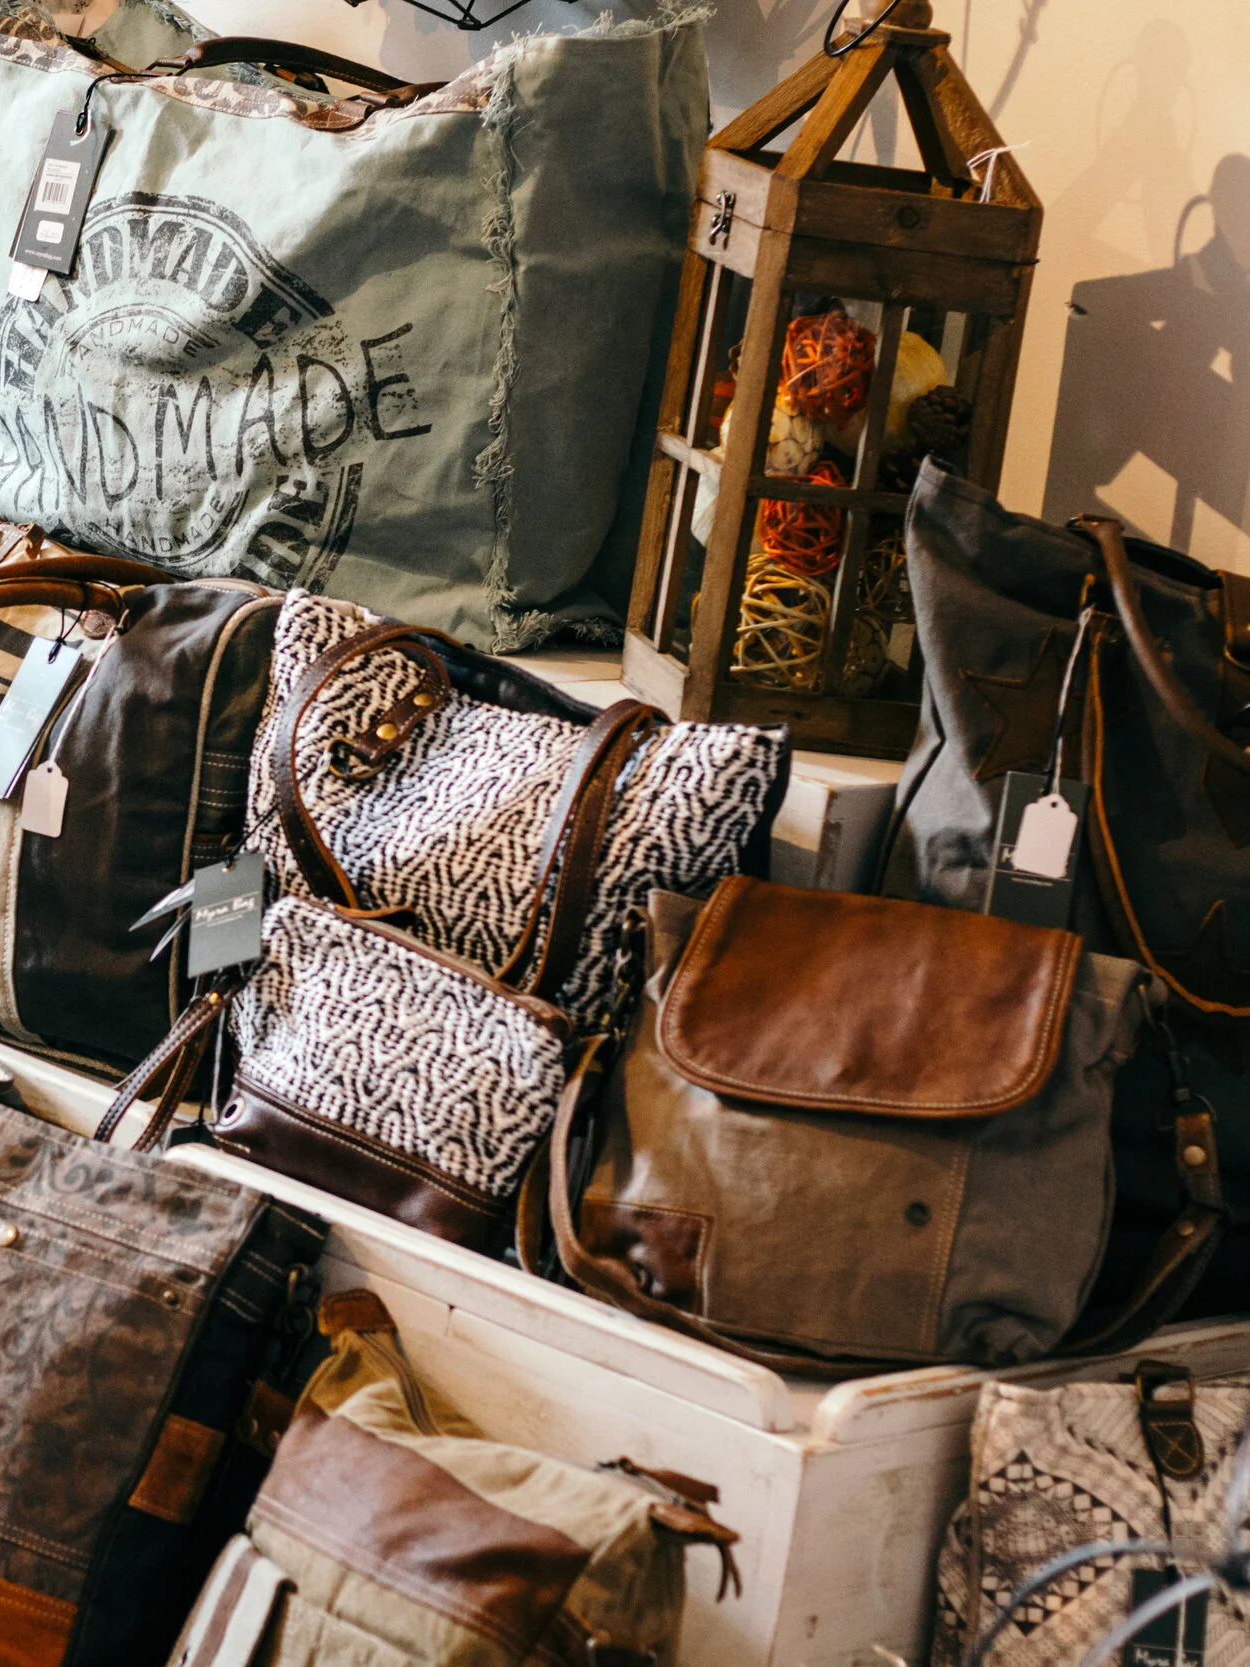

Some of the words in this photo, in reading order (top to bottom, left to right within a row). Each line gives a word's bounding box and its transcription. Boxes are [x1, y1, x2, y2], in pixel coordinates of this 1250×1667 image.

[2, 217, 303, 399] HANDMADE
[66, 318, 204, 381] HANDMADE
[105, 496, 225, 553] HANDMADE
